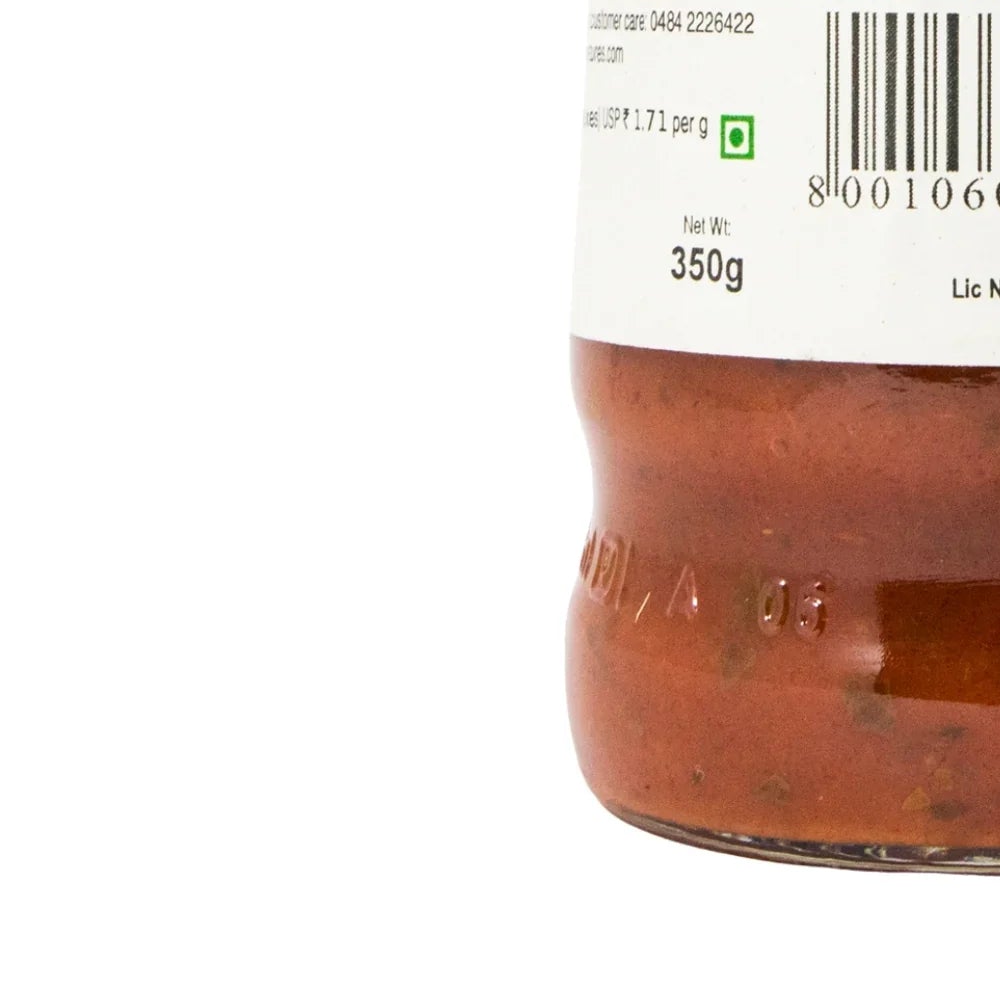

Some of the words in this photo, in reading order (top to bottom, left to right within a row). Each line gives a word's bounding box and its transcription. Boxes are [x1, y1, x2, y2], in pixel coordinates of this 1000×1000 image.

[650, 10, 682, 32] 0484
[687, 11, 754, 34] 2226422
[673, 115, 694, 138] per
[699, 117, 708, 139] g
[684, 216, 705, 234] Net
[671, 246, 743, 293] 350g
[952, 278, 981, 298] Lic
